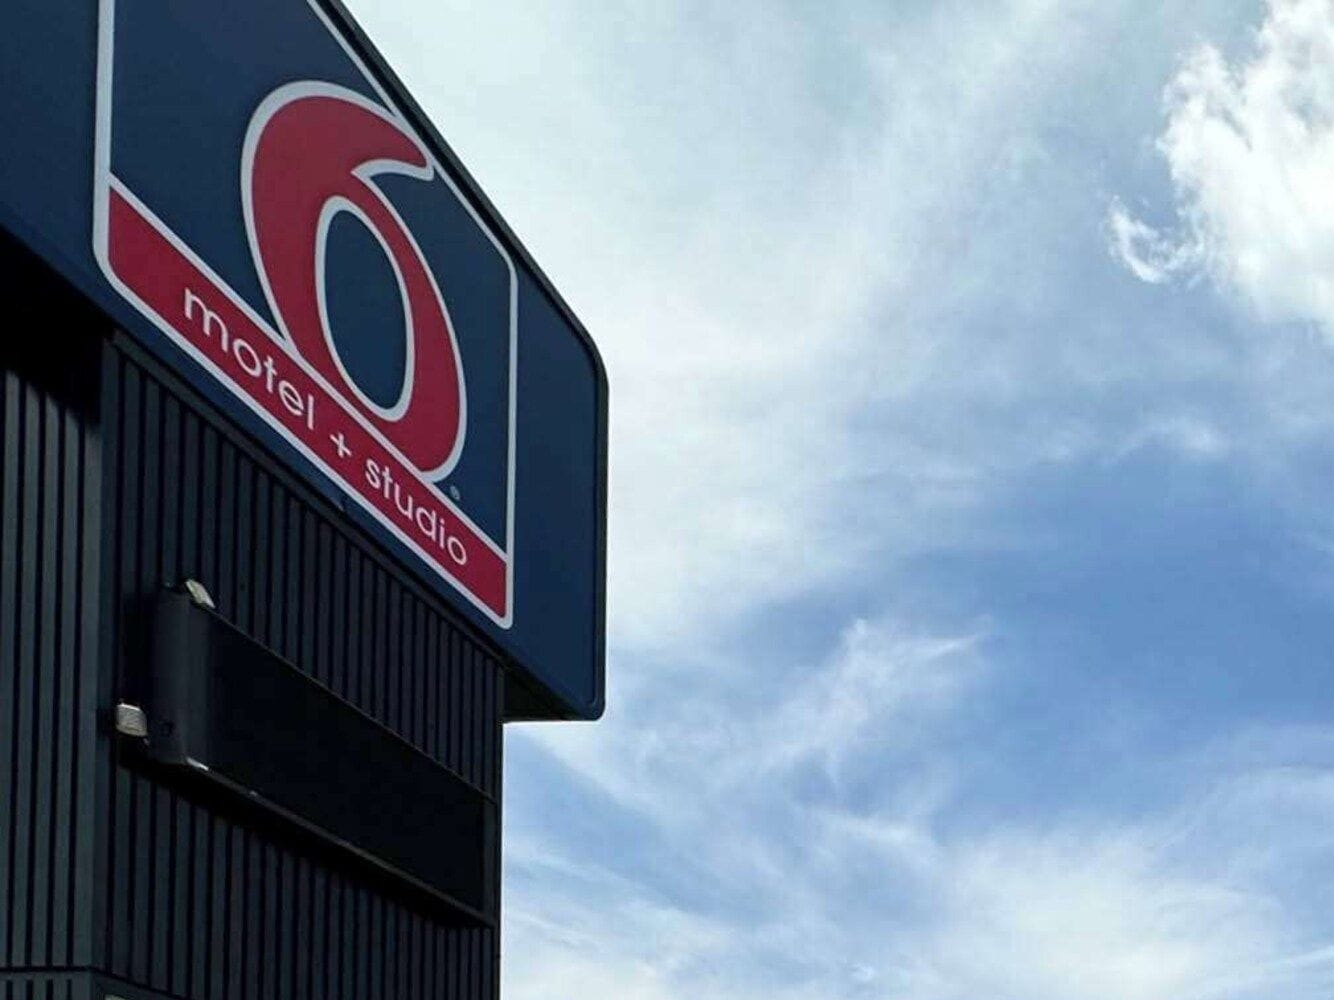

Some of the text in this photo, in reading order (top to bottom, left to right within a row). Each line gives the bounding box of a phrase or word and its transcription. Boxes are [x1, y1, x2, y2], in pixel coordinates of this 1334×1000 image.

[183, 287, 316, 430] motel
[366, 455, 467, 566] studio
[241, 81, 467, 483] 6
